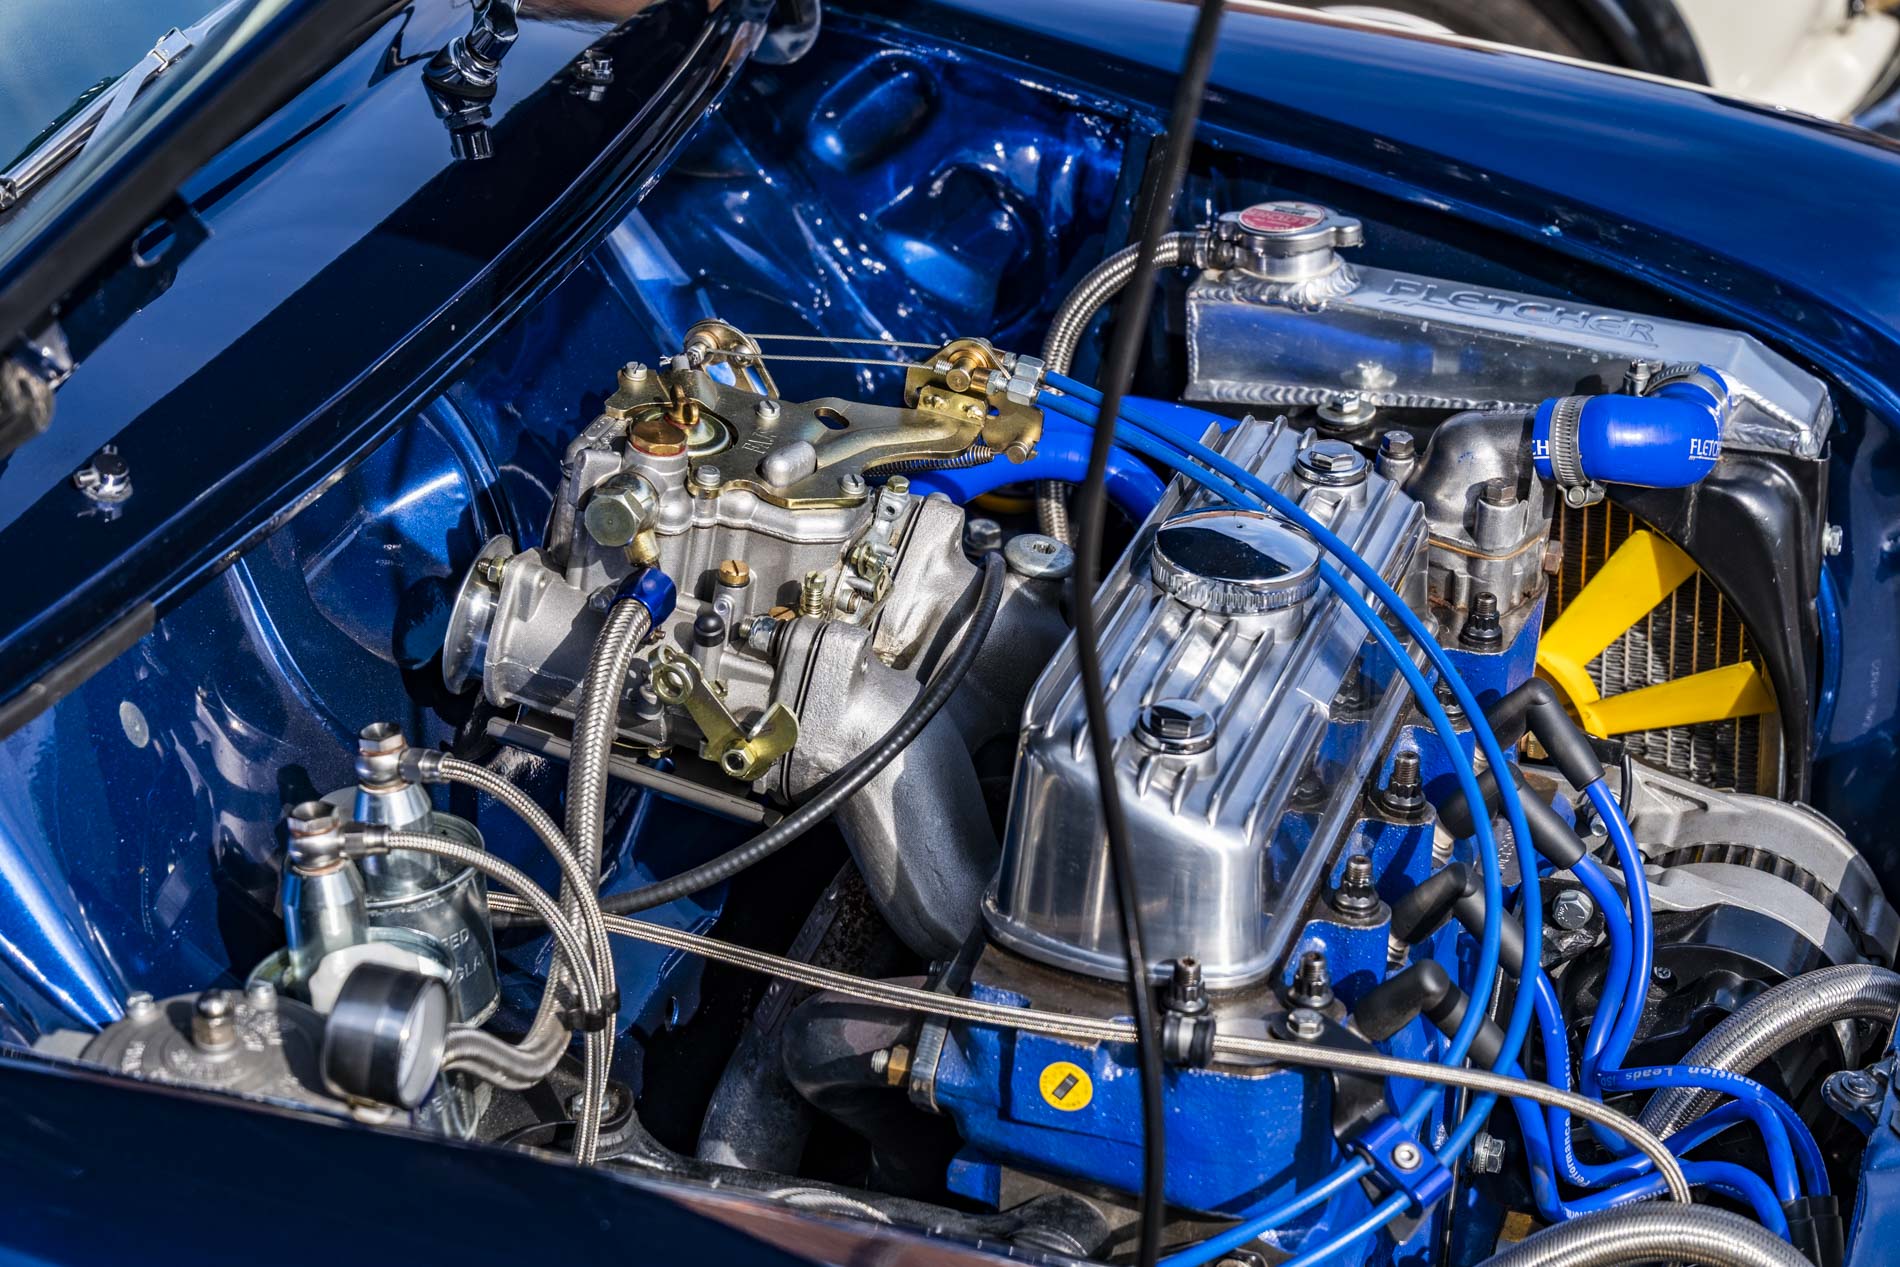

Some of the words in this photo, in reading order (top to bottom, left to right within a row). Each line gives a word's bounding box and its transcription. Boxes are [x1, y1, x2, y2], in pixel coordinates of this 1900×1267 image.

[1386, 278, 1656, 342] FLETCHER
[1625, 1067, 1674, 1081] Leads
[1688, 1066, 1763, 1092] Ignition
[1564, 1116, 1592, 1188] Performance
